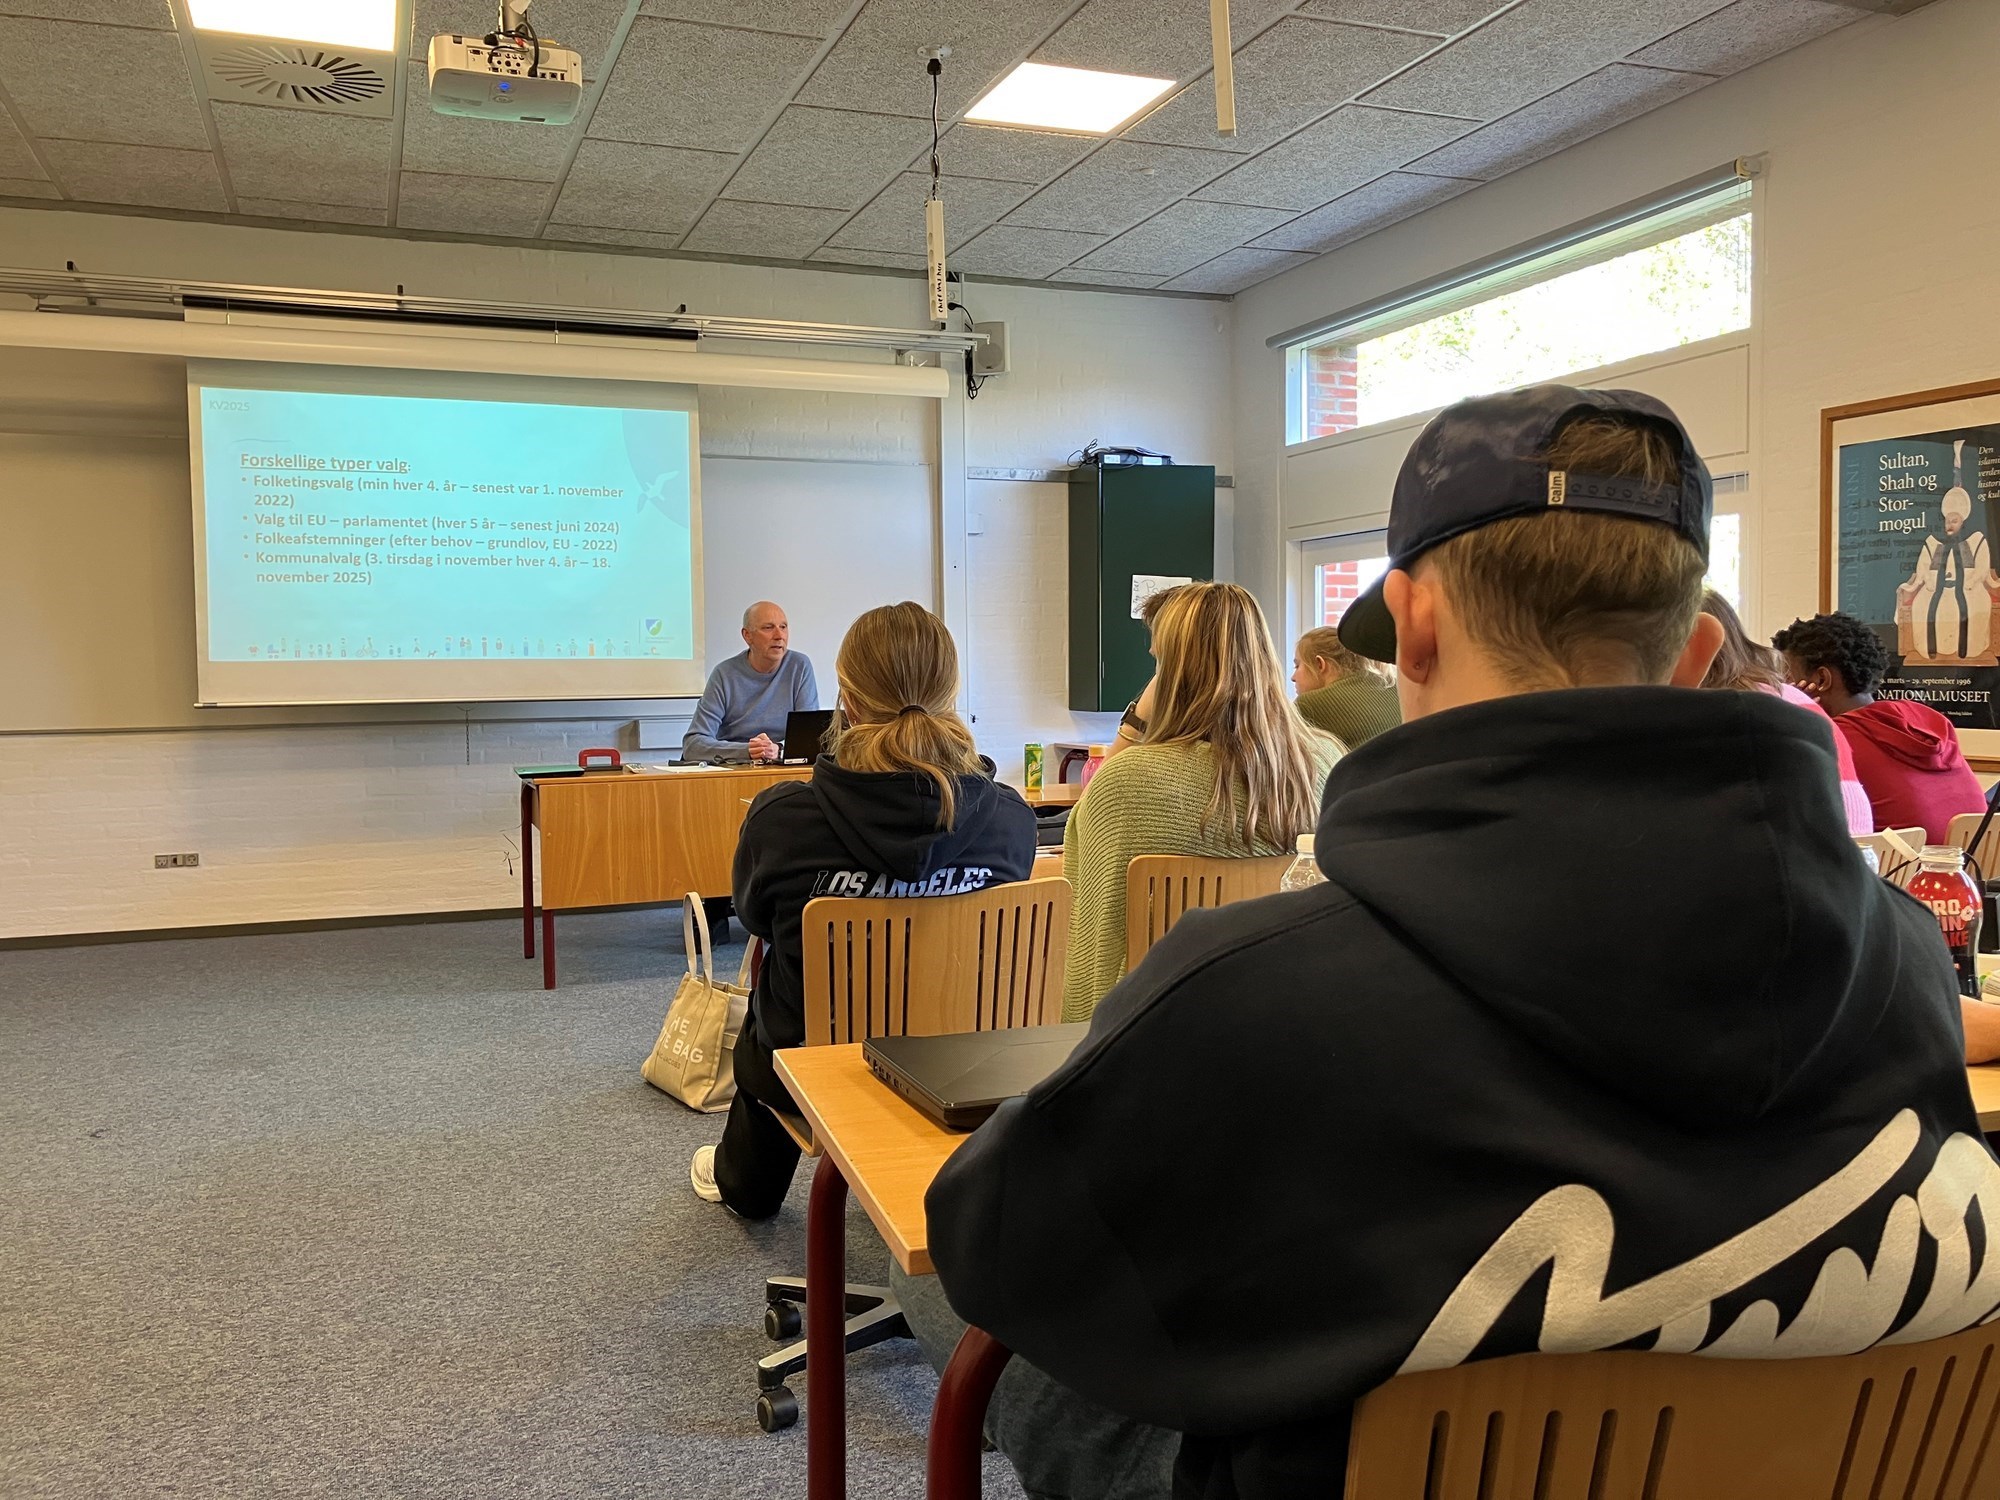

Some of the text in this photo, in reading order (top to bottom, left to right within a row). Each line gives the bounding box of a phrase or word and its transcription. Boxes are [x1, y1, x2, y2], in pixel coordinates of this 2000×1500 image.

[209, 400, 250, 411] KV2025
[1978, 446, 1994, 455] Den
[240, 453, 411, 474] Forskellige typer valg:
[1879, 452, 1929, 470] Sultan,
[253, 475, 354, 491] Folketingsvalg
[358, 477, 388, 492] (min
[393, 478, 423, 491] hver
[427, 480, 439, 491] 4.
[443, 479, 456, 492] år
[472, 483, 514, 494] senest
[518, 485, 539, 495] var
[543, 484, 554, 495] 1.
[558, 486, 623, 498] november
[1879, 473, 1938, 492] Shah og
[254, 494, 295, 508] 2022)
[1879, 497, 1914, 512] Stor-
[1977, 493, 1987, 502] og
[254, 513, 285, 527] Valg
[289, 514, 303, 525] til
[307, 515, 326, 526] EU
[343, 515, 428, 528] parlamentet
[432, 516, 466, 530] (hver
[470, 518, 477, 529] 5
[482, 517, 496, 529] år
[510, 520, 552, 531] senest
[556, 520, 580, 533] juni
[584, 522, 620, 534] 2024)
[1879, 512, 1926, 534] mogul
[255, 532, 385, 547] Folkeafstemninger
[389, 534, 427, 548] (efter
[431, 535, 472, 547] behov
[488, 537, 549, 551] grundlov,
[553, 539, 570, 550] EU
[582, 539, 618, 552] 2022)
[256, 551, 361, 566] Kommunalvalg
[365, 552, 382, 566] (3.
[386, 553, 433, 567] tirsdag
[436, 554, 440, 565] i
[445, 554, 512, 566] november
[516, 555, 545, 567] hver
[548, 556, 560, 567] 4.
[564, 555, 577, 568] år
[592, 557, 611, 568] 18.
[256, 571, 372, 585] november 2025)
[1887, 677, 1905, 685] marts
[1922, 676, 1955, 687] september
[1956, 678, 1972, 687] 1996
[1877, 689, 1990, 702] NATIONALMUSEET
[809, 870, 868, 898] LOS
[1937, 915, 1964, 931] IN
[672, 1038, 704, 1064] BAG
